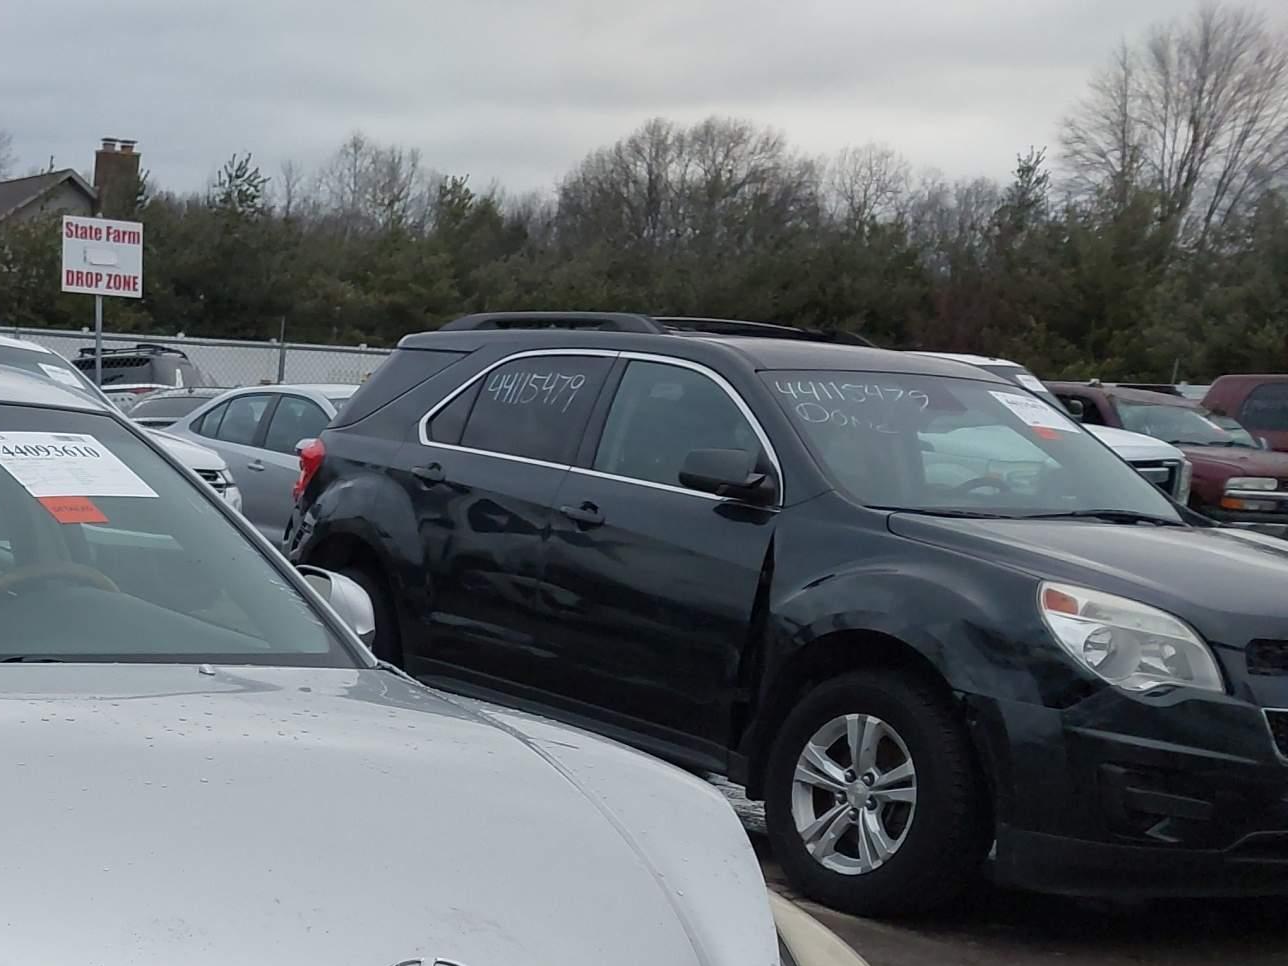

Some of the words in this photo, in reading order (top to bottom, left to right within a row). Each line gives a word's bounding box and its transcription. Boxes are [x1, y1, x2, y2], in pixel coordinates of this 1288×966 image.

[65, 221, 102, 241] State
[106, 226, 140, 245] Farm
[65, 269, 103, 289] DROP
[105, 273, 139, 292] ZONE
[488, 372, 585, 414] 44115479
[1, 445, 101, 458] 44093610
